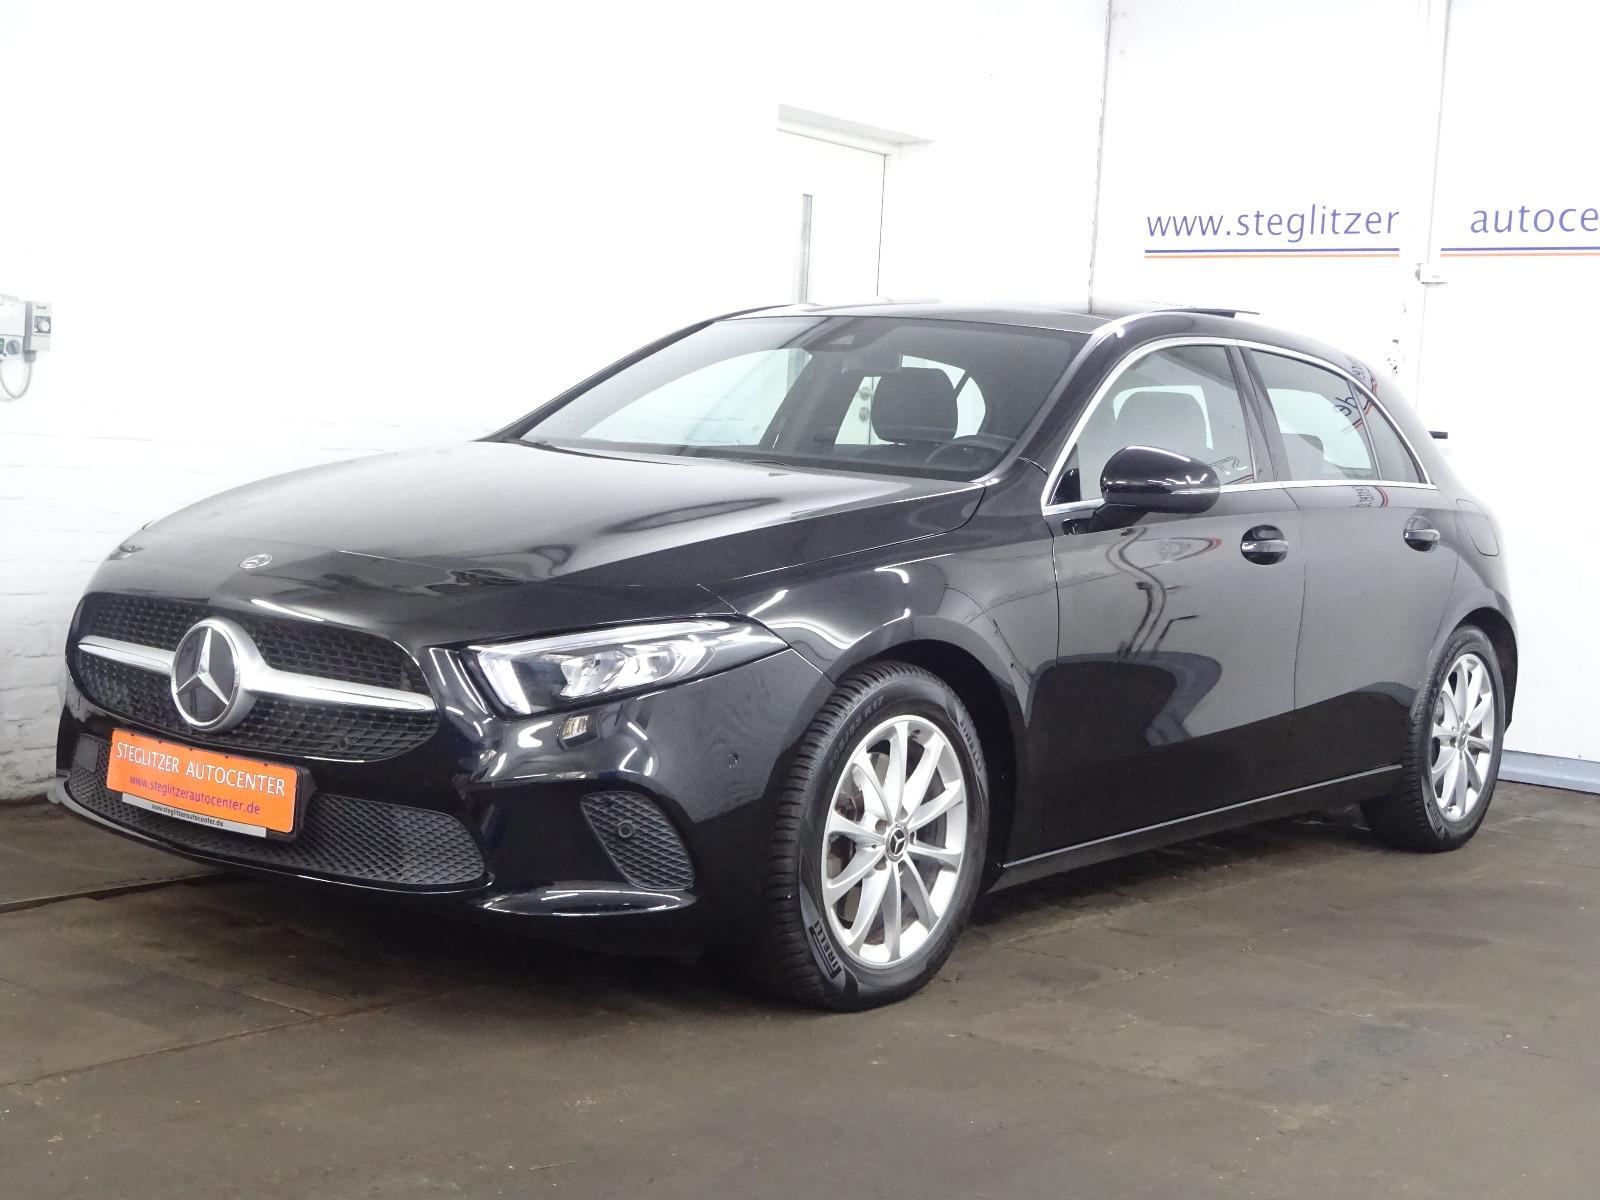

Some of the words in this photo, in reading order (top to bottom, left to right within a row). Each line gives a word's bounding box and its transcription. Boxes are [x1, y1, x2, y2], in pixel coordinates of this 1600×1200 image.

[1146, 203, 1400, 243] www.steglitzer
[1470, 205, 1599, 233] autoce
[116, 741, 180, 774] STEGLITZER
[185, 761, 285, 797] AUTOCENTER
[129, 774, 261, 815] www.steglitzerautocenter.de
[809, 919, 842, 979] PIRELLI
